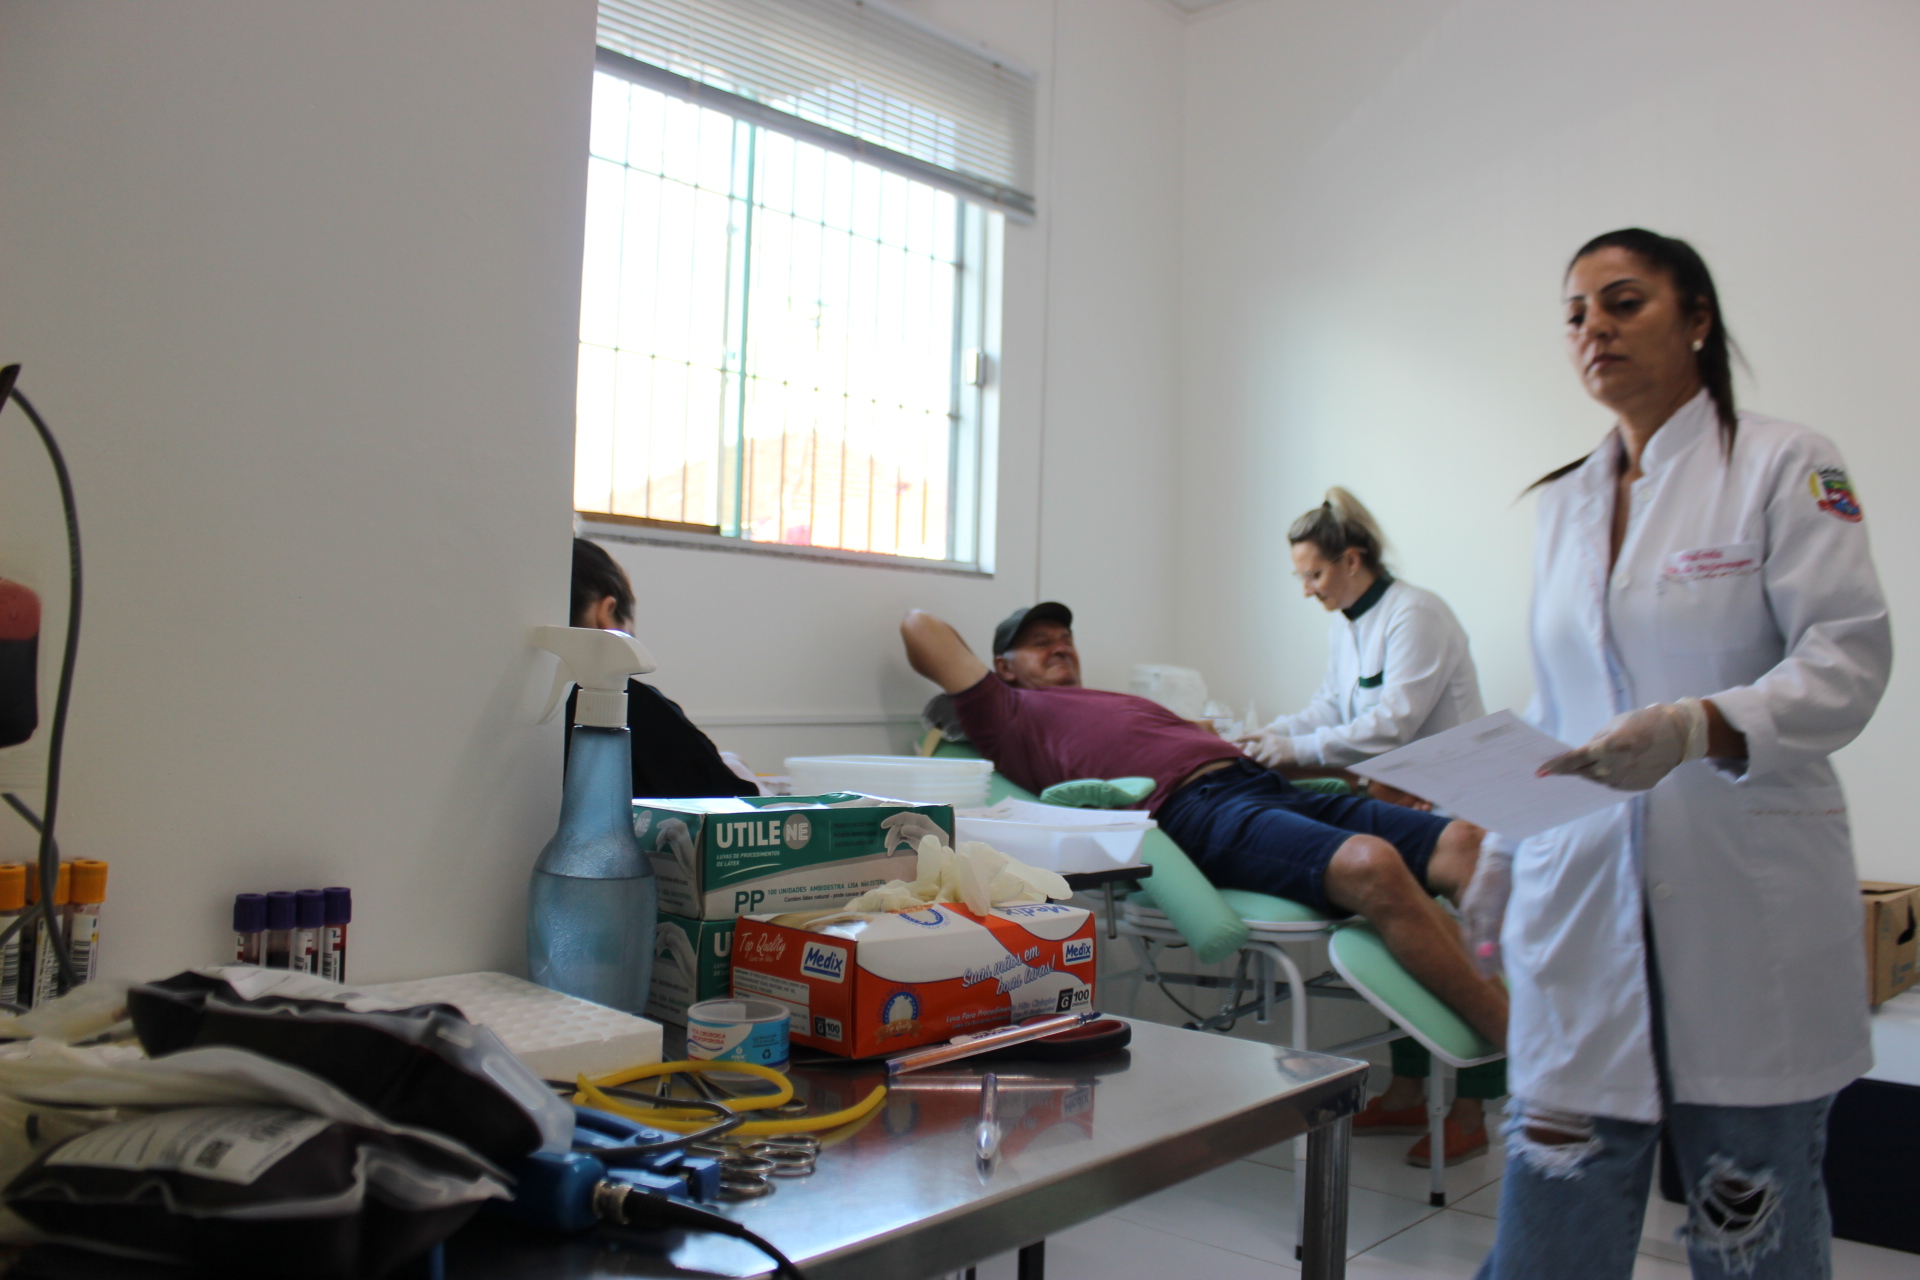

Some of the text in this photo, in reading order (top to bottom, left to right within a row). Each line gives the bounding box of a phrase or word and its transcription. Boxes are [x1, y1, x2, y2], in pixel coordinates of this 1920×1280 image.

[778, 887, 807, 895] UNIDADES
[810, 883, 845, 892] AMBIDESTRA
[734, 889, 765, 913] PP
[739, 932, 754, 959] Top
[756, 933, 787, 961] Quality
[1065, 942, 1091, 958] Medix
[804, 946, 844, 973] Medix
[961, 946, 1040, 989] Suas mãos em
[996, 975, 1022, 996] boas
[1061, 996, 1069, 1009] G
[1074, 989, 1089, 1001] 100
[827, 1022, 840, 1034] 100
